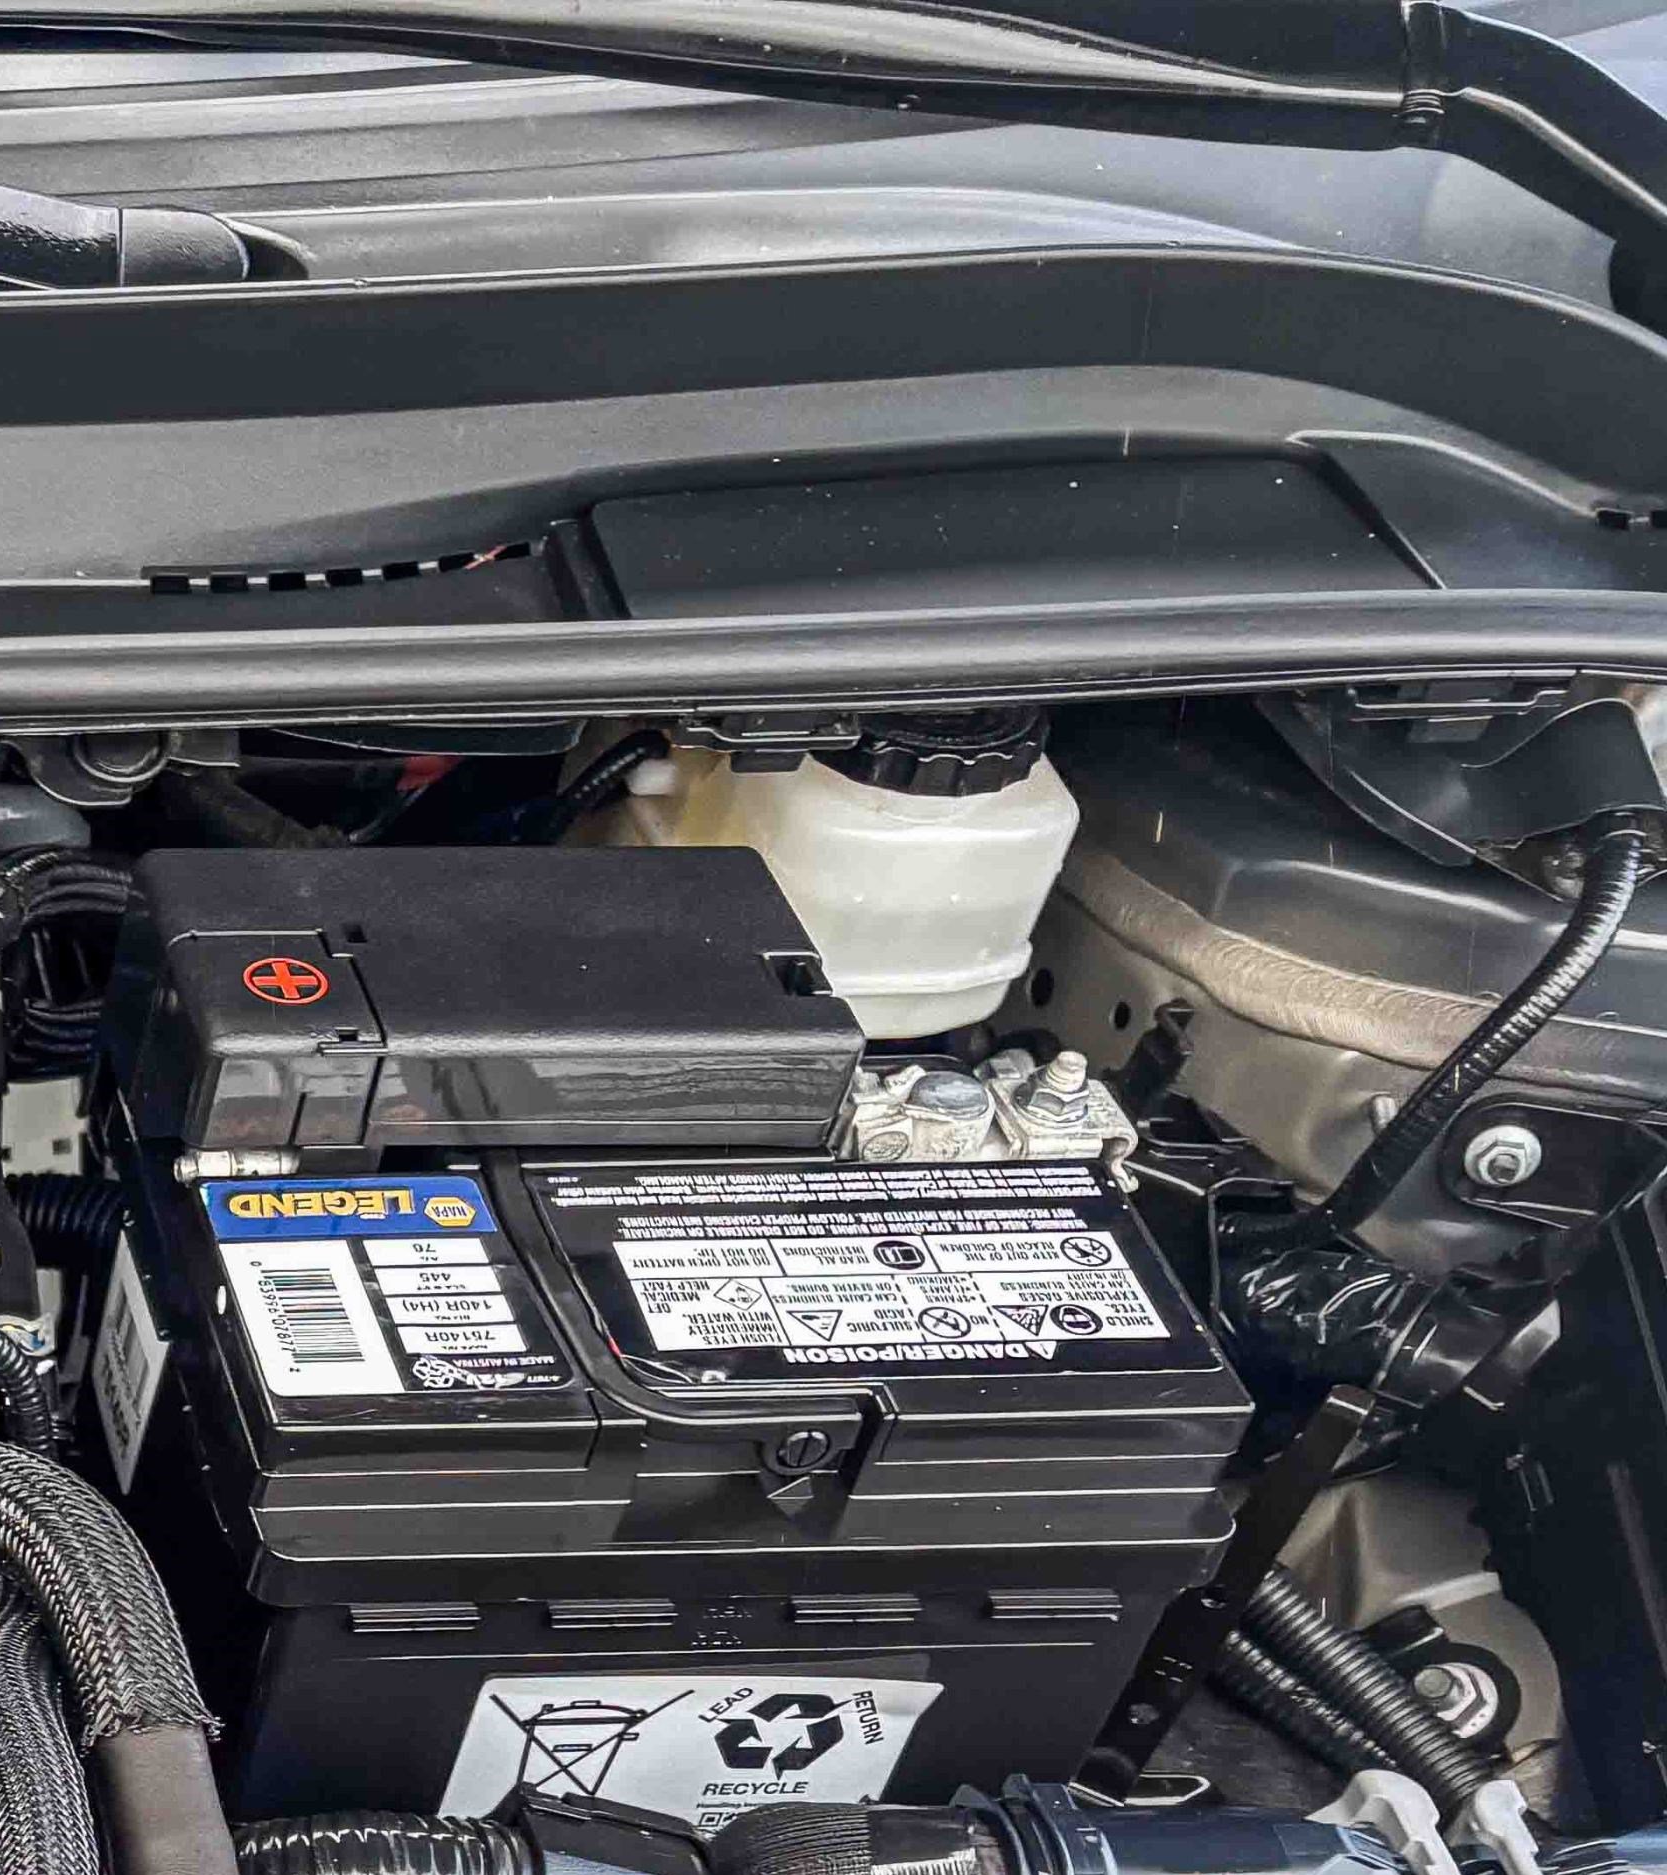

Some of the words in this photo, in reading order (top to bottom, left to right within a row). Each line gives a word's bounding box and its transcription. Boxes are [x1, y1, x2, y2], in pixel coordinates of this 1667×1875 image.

[228, 1189, 414, 1219] LEGEND
[431, 1205, 466, 1217] NAPA
[641, 1281, 672, 1292] FAST
[677, 1280, 710, 1291] HELP
[641, 1291, 698, 1302] MEDICAL
[1065, 1291, 1139, 1301] EXPLOSIVE
[402, 1299, 439, 1312] (H4)
[445, 1299, 492, 1311] 140R
[682, 1312, 735, 1324] WATER.
[736, 1312, 773, 1322] WITH
[873, 1309, 905, 1319] ACID
[970, 1315, 989, 1325] NO
[1106, 1317, 1153, 1326] SHIELD
[688, 1323, 776, 1336] IMMEDIATELY
[847, 1322, 912, 1332] SULFURIC
[272, 1319, 296, 1351] 07877
[424, 1330, 495, 1342] 75140R
[702, 1335, 736, 1345] EYES
[741, 1333, 781, 1344] FLUSH
[783, 1343, 1027, 1363] DANGER/POISON
[452, 1359, 502, 1367] AUSTRIA
[504, 1358, 518, 1366] IN
[518, 1356, 555, 1365] MADE
[698, 1688, 754, 1723] LEAD
[852, 1690, 885, 1746] RETURN
[702, 1782, 809, 1796] RECYCLE
